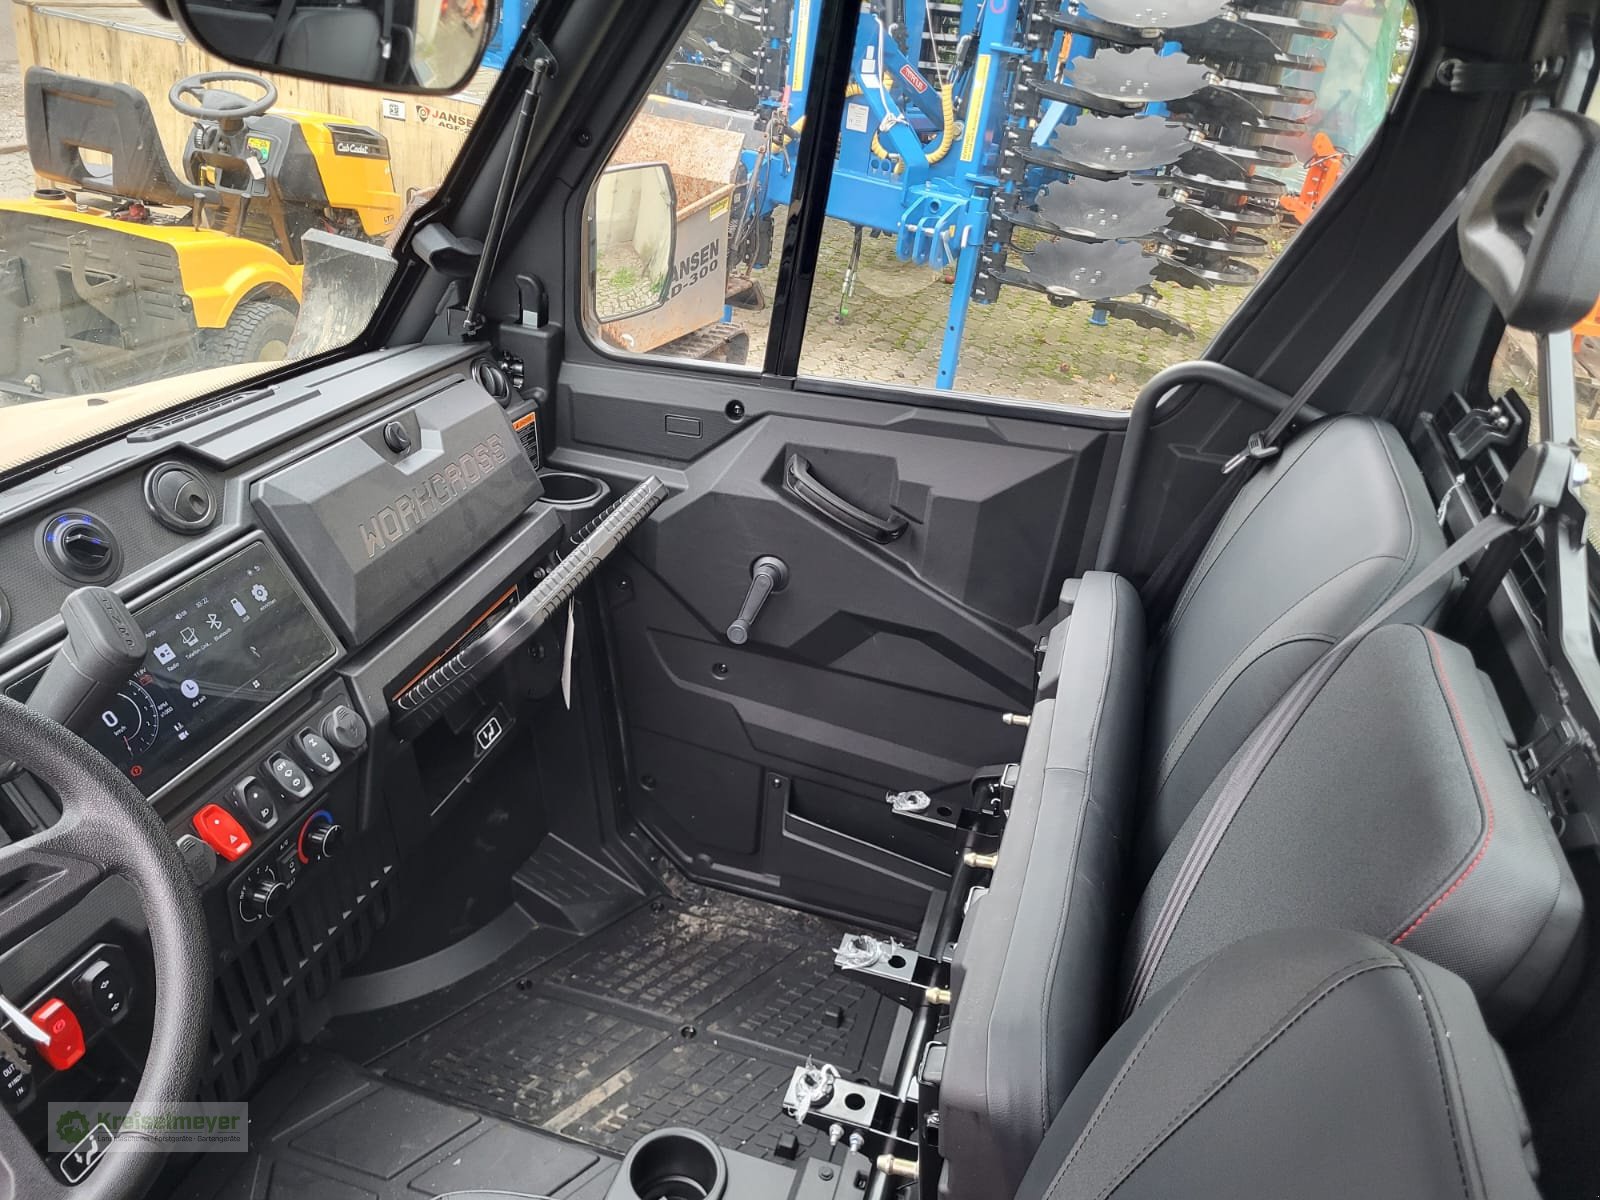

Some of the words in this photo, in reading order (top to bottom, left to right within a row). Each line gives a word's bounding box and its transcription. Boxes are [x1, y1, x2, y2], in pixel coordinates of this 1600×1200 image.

[432, 110, 474, 128] JANSE
[672, 238, 719, 281] ANSEN
[667, 259, 718, 301] D-300
[358, 433, 507, 559] WORKCROSS
[102, 710, 119, 728] 0
[2, 1063, 16, 1078] OUT
